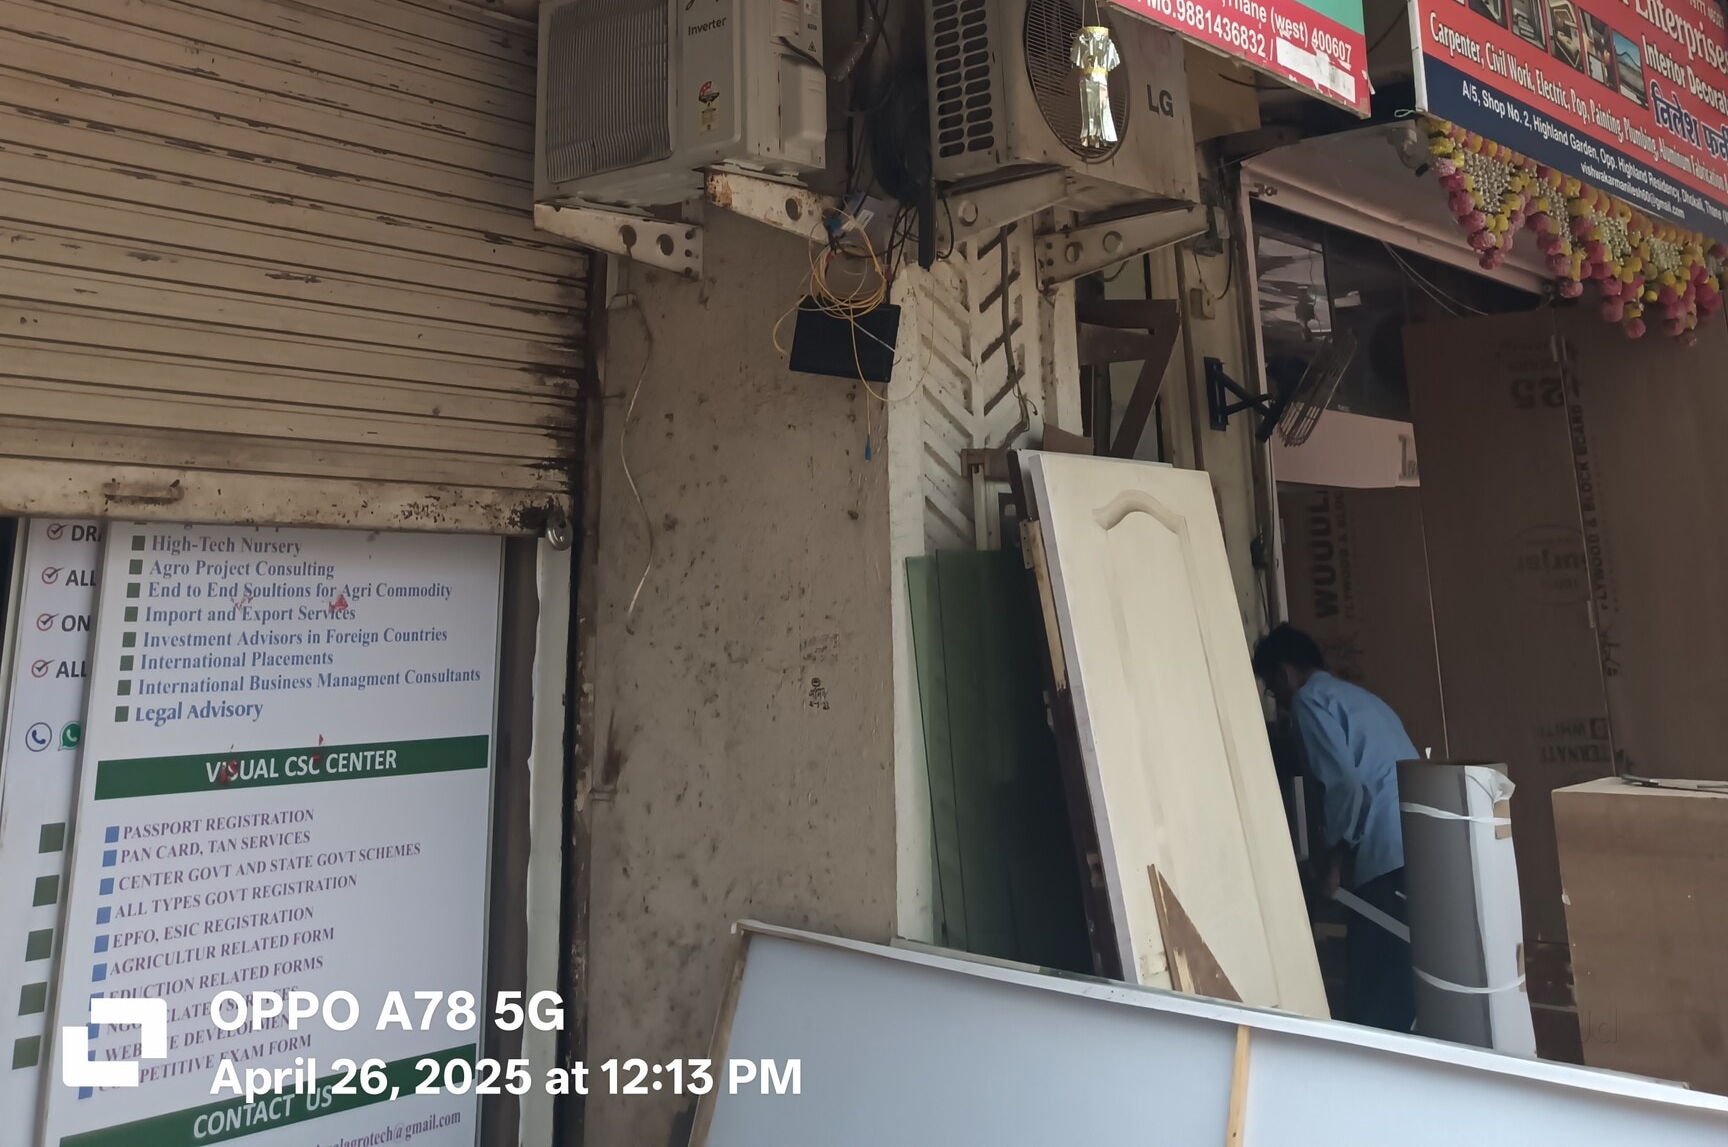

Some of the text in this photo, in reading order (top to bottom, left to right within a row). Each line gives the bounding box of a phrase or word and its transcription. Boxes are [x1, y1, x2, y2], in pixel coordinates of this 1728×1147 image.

[688, 17, 727, 36] Inverter
[1270, 6, 1309, 47] (west)
[1311, 27, 1352, 67] 400607
[1429, 11, 1485, 69] Carpenter,
[1485, 42, 1508, 77] Civil
[1506, 53, 1536, 94] Work,
[1535, 69, 1571, 113] Electric,
[1570, 88, 1591, 125] Pop,
[1642, 35, 1686, 88] Interior
[1146, 83, 1174, 118] LG
[1462, 79, 1481, 107] A/5,
[1481, 89, 1506, 119] Shop
[1506, 101, 1523, 124] No.
[1523, 110, 1533, 131] 2,
[1532, 114, 1569, 146] Highland
[1569, 132, 1600, 163] Garden,
[1599, 147, 1618, 171] Opp.
[1617, 156, 1648, 184] Highland
[152, 535, 300, 558] High-Tech Nursery
[149, 559, 335, 580] Agro Project Consulting
[148, 581, 181, 598] End
[186, 584, 202, 598] to
[207, 581, 239, 598] End
[316, 582, 337, 598] for
[341, 582, 372, 602] Agri
[375, 582, 451, 601] Commodity
[135, 699, 264, 728] Legal Advisory
[325, 749, 397, 774] CENTER
[123, 808, 314, 840] PASSPORT REGISTRATION
[121, 830, 311, 864] PAN CARD, TAN SERVICES
[194, 1094, 296, 1139] CONTACT
